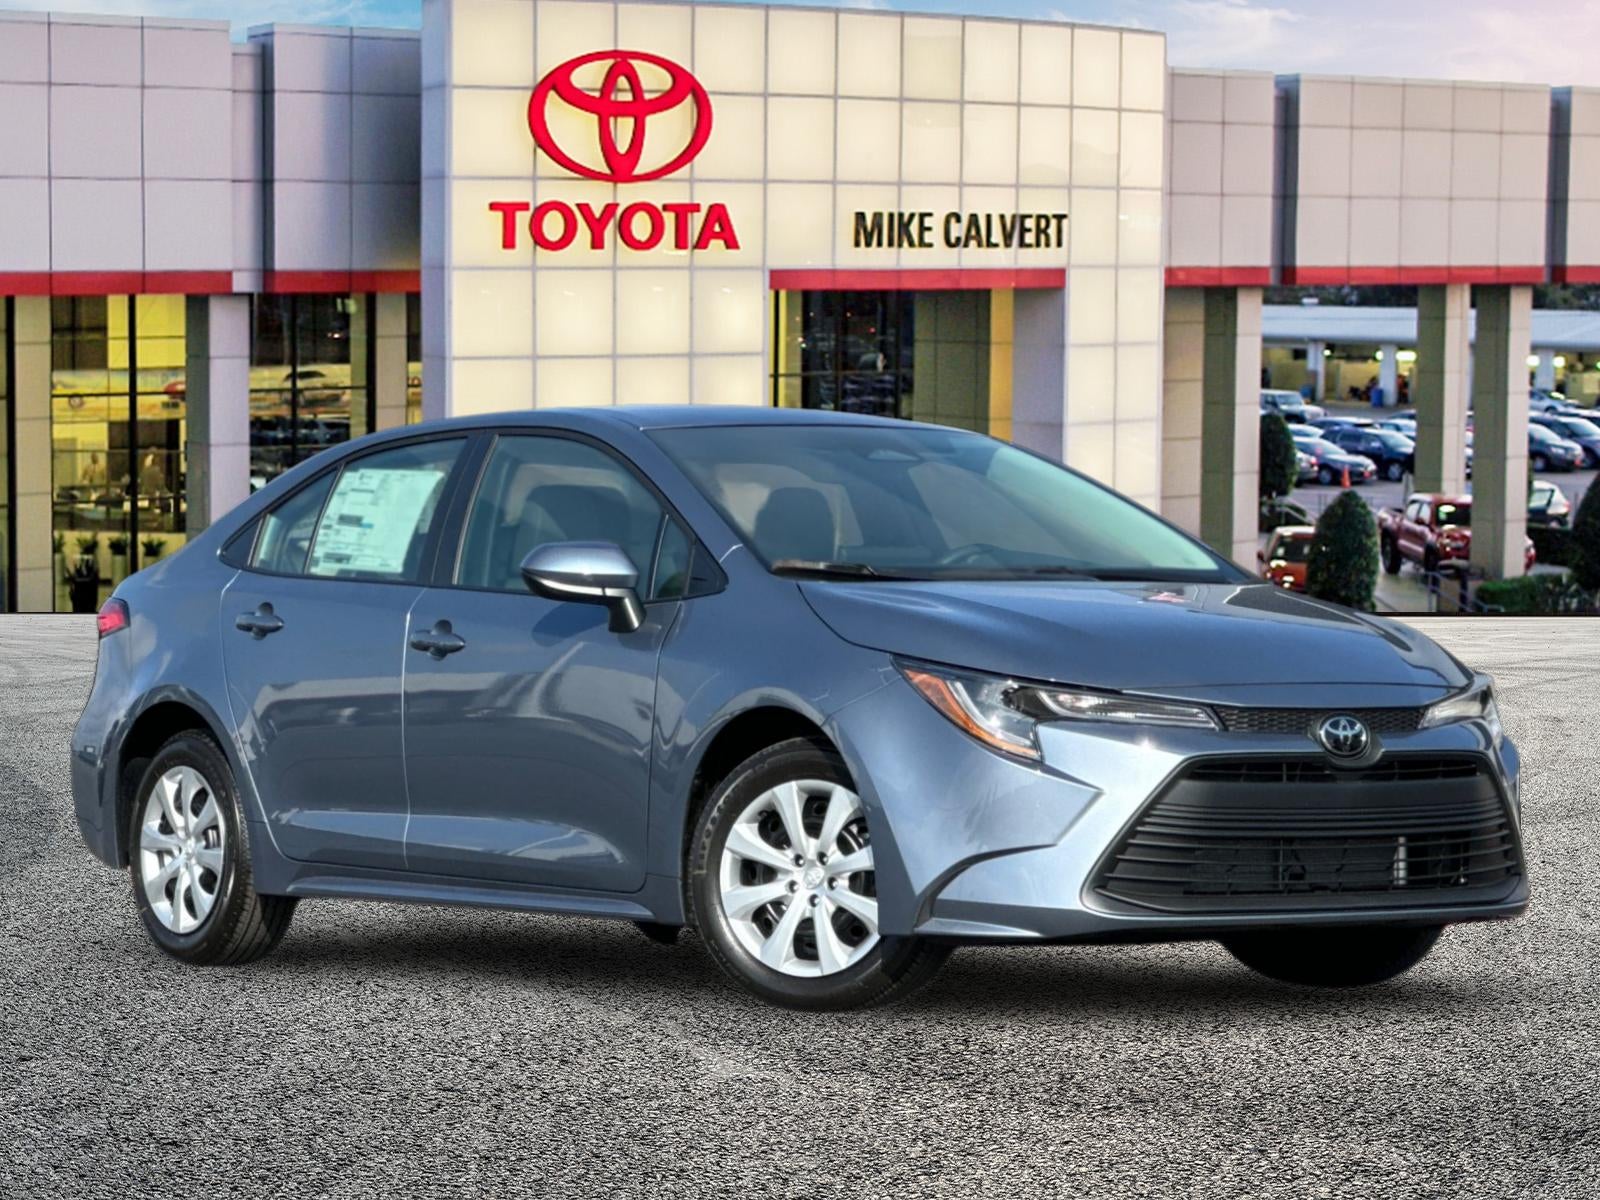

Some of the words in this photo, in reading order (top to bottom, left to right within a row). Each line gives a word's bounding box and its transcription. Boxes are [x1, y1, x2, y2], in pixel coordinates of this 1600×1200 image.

[489, 201, 740, 251] TOYOTA
[853, 211, 934, 248] MIKE
[943, 212, 1068, 249] CALVERT
